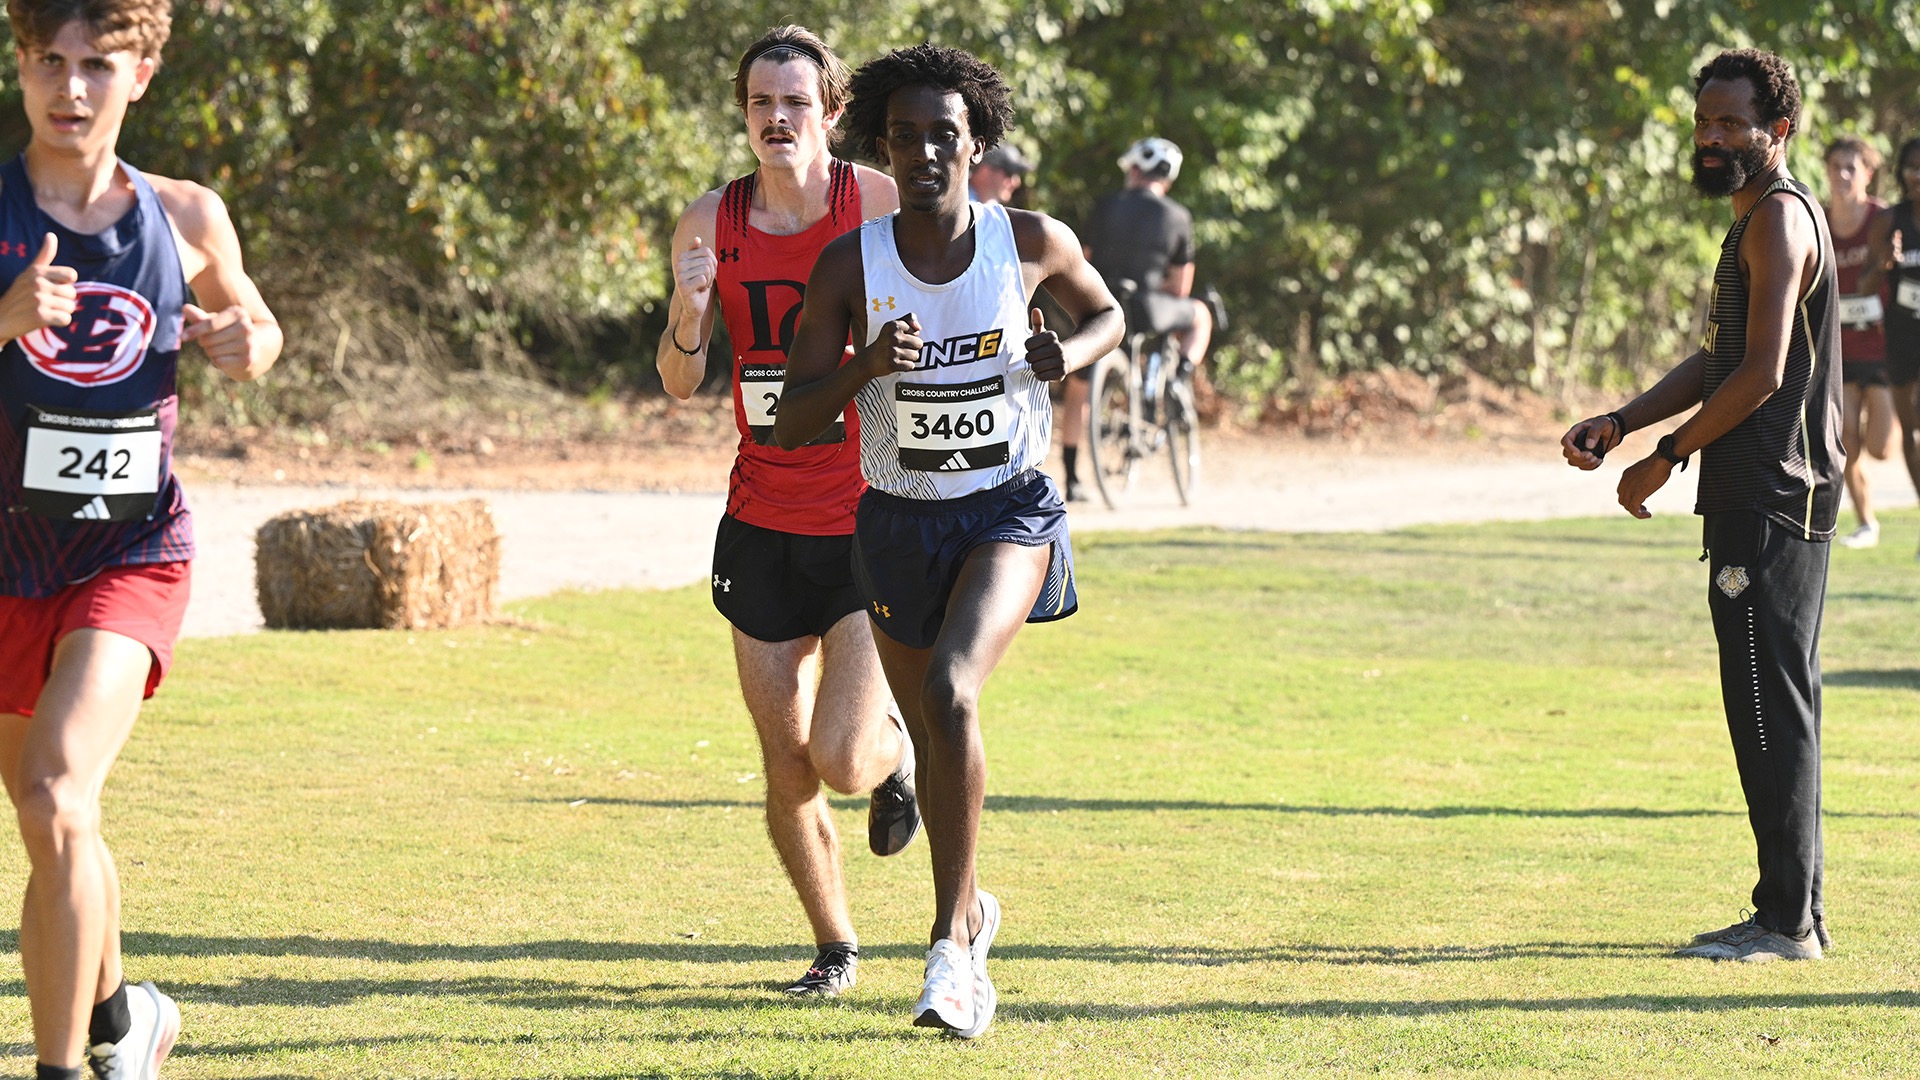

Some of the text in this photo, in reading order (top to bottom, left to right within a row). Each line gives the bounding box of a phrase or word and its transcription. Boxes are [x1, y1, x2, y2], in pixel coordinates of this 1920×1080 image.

[744, 369, 786, 377] CROSS COUNT
[901, 382, 999, 398] CROSS COUNTRY CHALLENGE
[911, 409, 994, 440] 3460
[58, 446, 131, 480] 242
